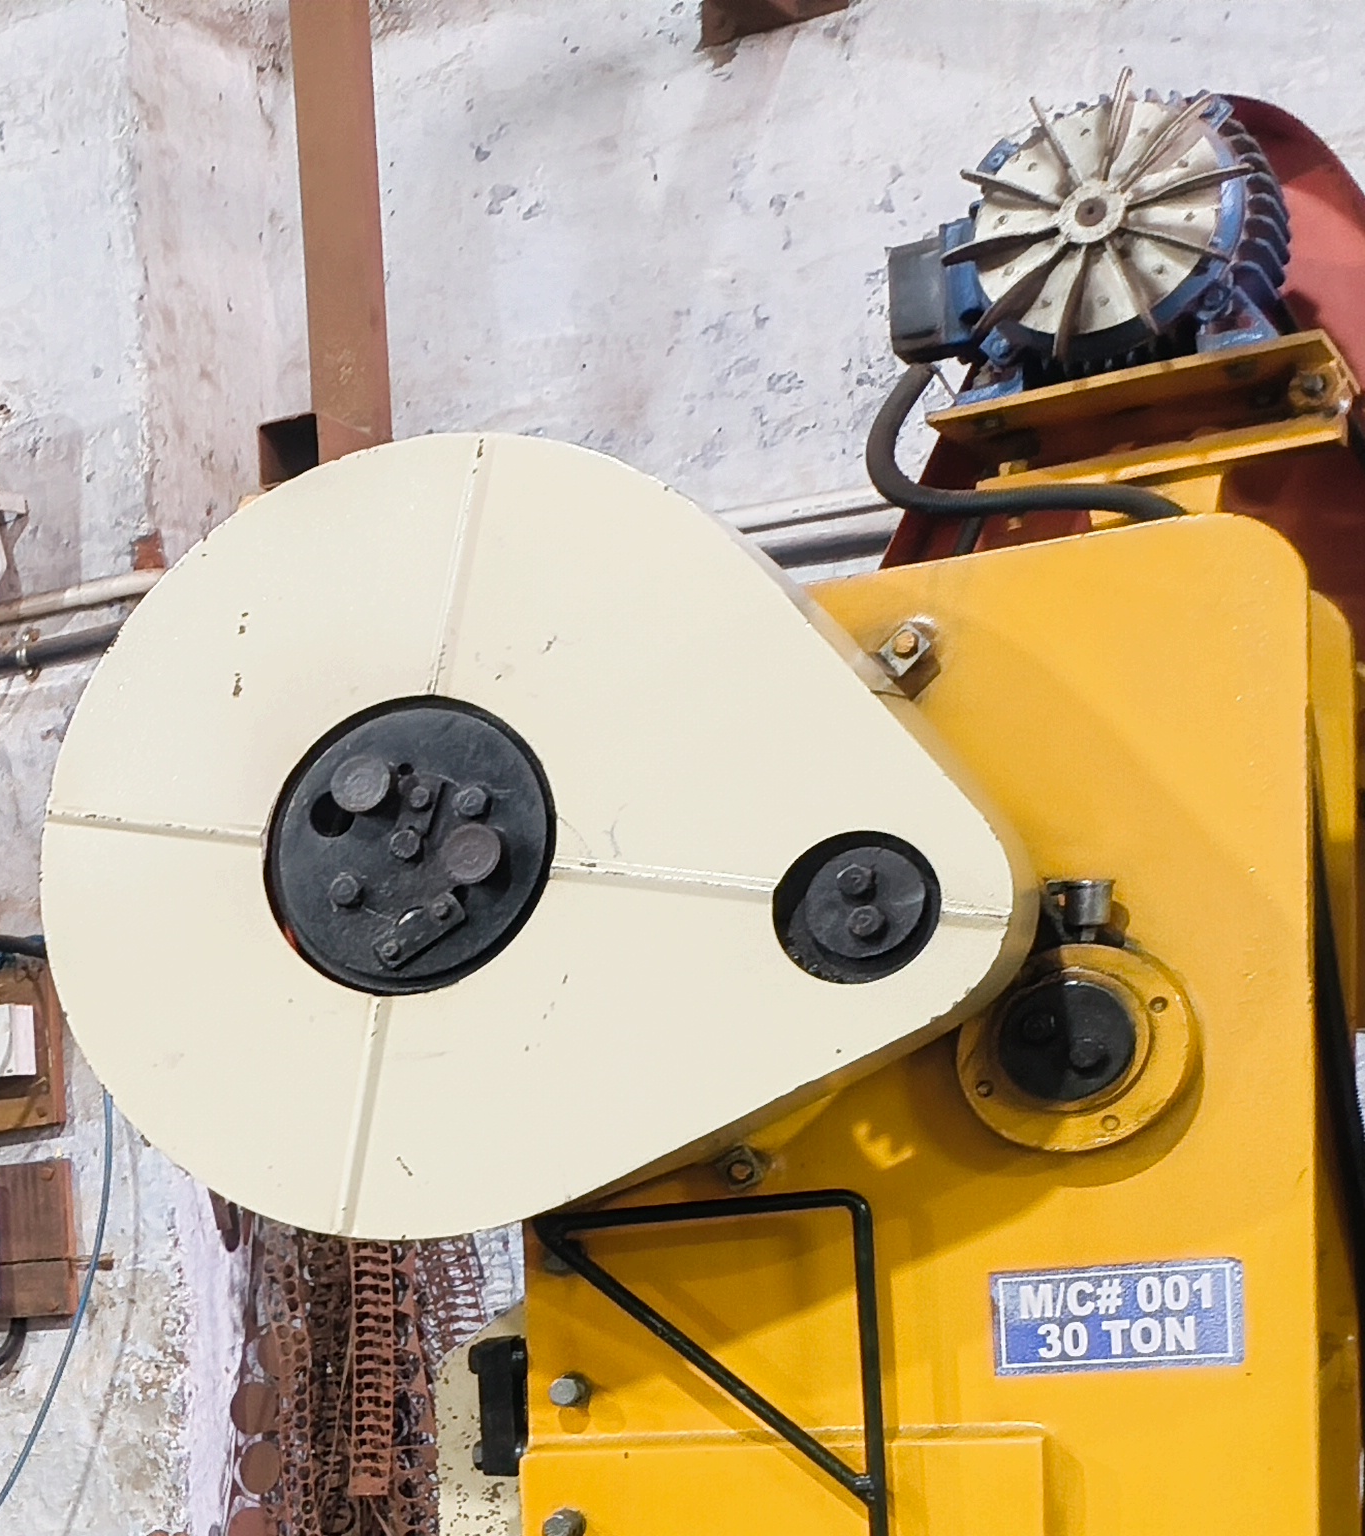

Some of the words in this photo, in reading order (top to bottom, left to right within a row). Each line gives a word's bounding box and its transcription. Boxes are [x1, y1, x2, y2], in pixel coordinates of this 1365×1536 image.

[1019, 1278, 1123, 1320] M/C#
[1136, 1273, 1214, 1313] 001
[1037, 1321, 1089, 1359] 30
[1101, 1315, 1197, 1356] TON
